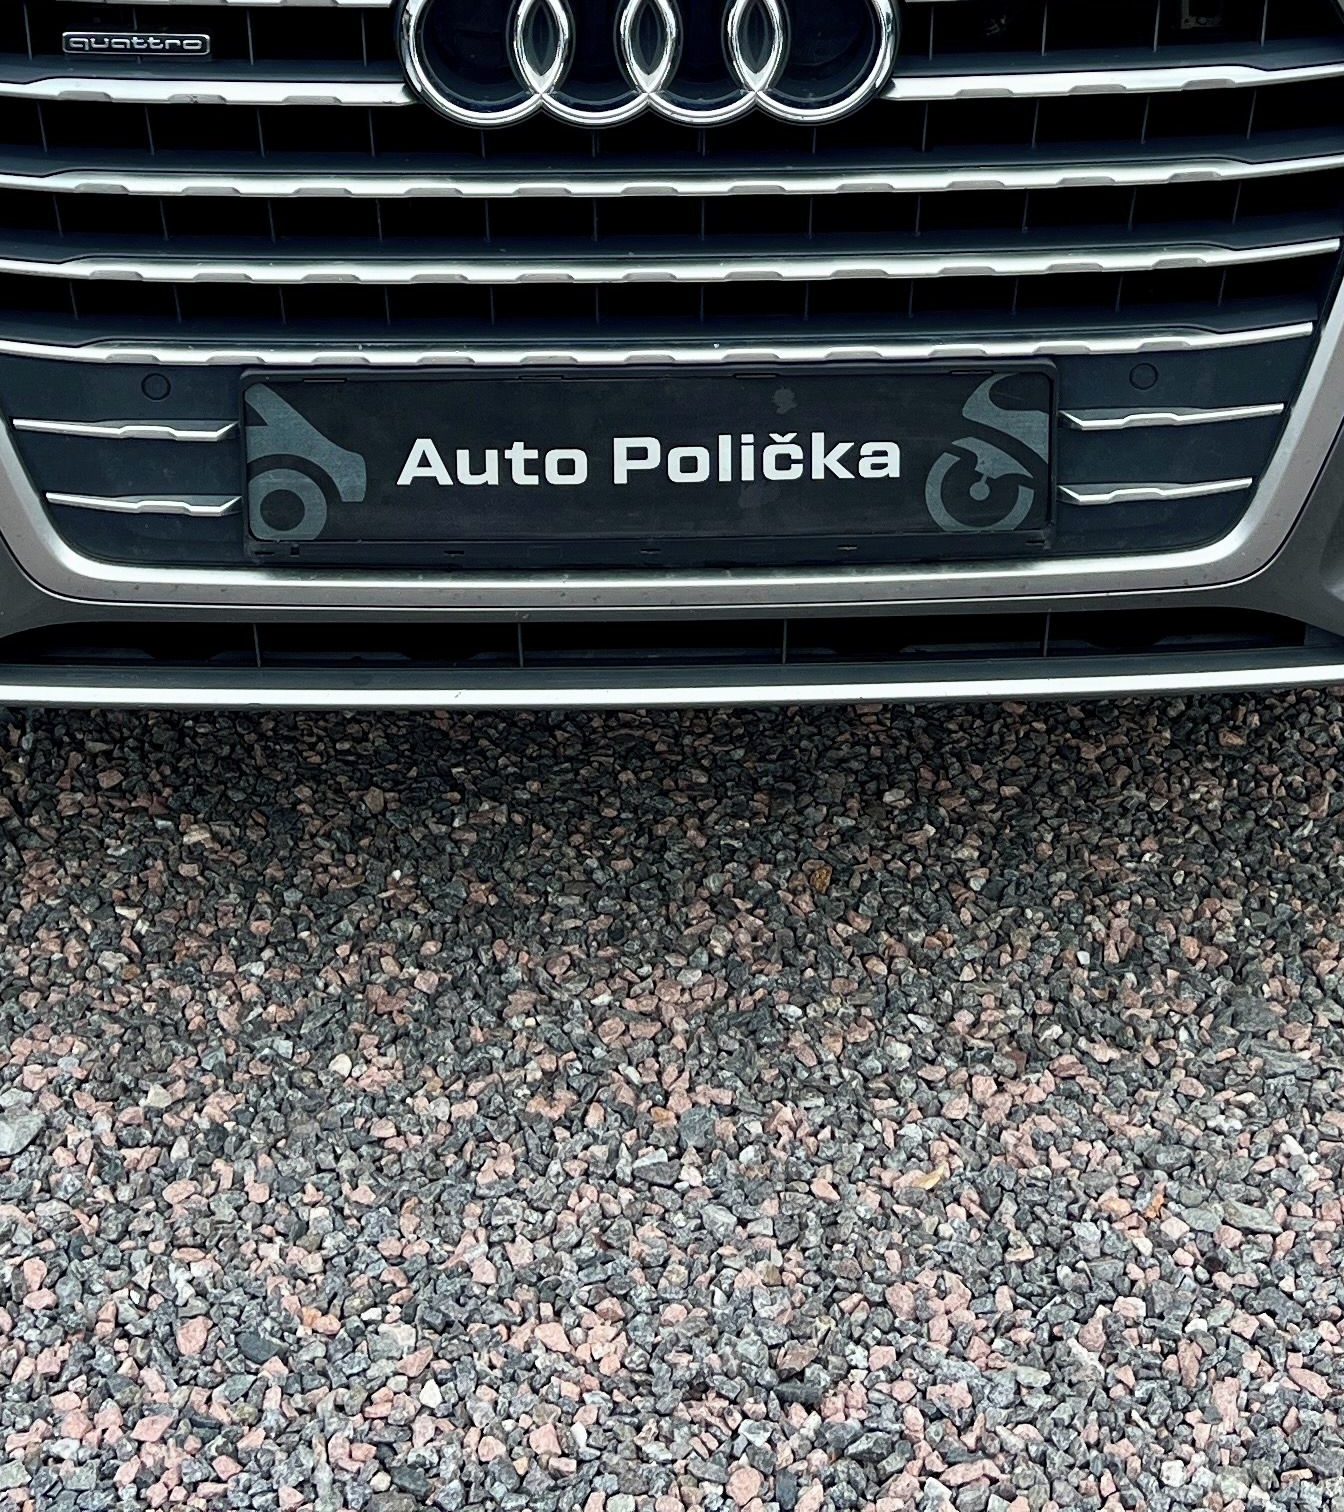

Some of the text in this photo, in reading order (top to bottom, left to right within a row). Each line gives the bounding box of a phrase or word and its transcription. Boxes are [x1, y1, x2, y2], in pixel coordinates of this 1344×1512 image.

[69, 36, 202, 50] quattro
[396, 431, 901, 486] Auto Polička
